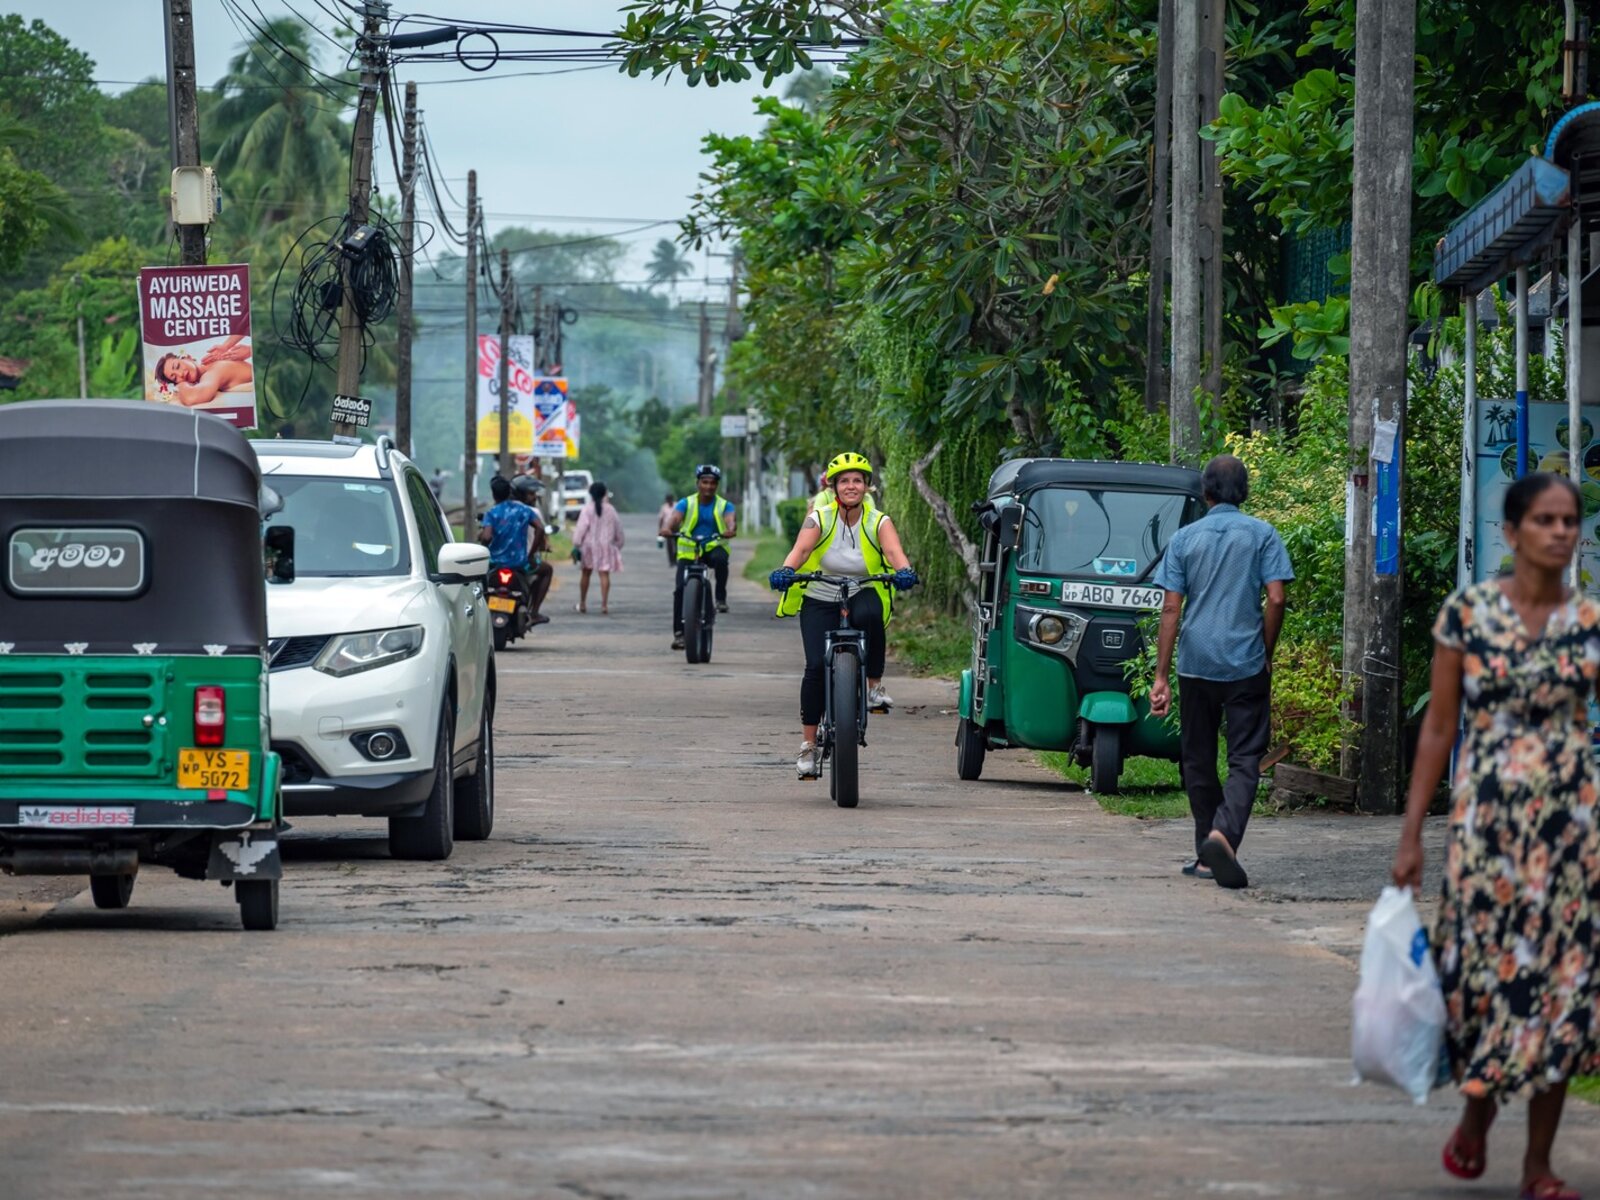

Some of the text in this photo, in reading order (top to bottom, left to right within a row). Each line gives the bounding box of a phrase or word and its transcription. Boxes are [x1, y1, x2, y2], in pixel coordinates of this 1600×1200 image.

[149, 274, 242, 294] AYURWEDA
[150, 294, 242, 319] MASSAGE
[164, 318, 231, 337] CENTER
[1064, 585, 1163, 608] WP ABQ 7649
[1105, 635, 1121, 645] RE
[182, 763, 200, 775] WP
[204, 751, 227, 769] YS
[200, 770, 240, 788] 5072
[49, 807, 129, 825] adidas
